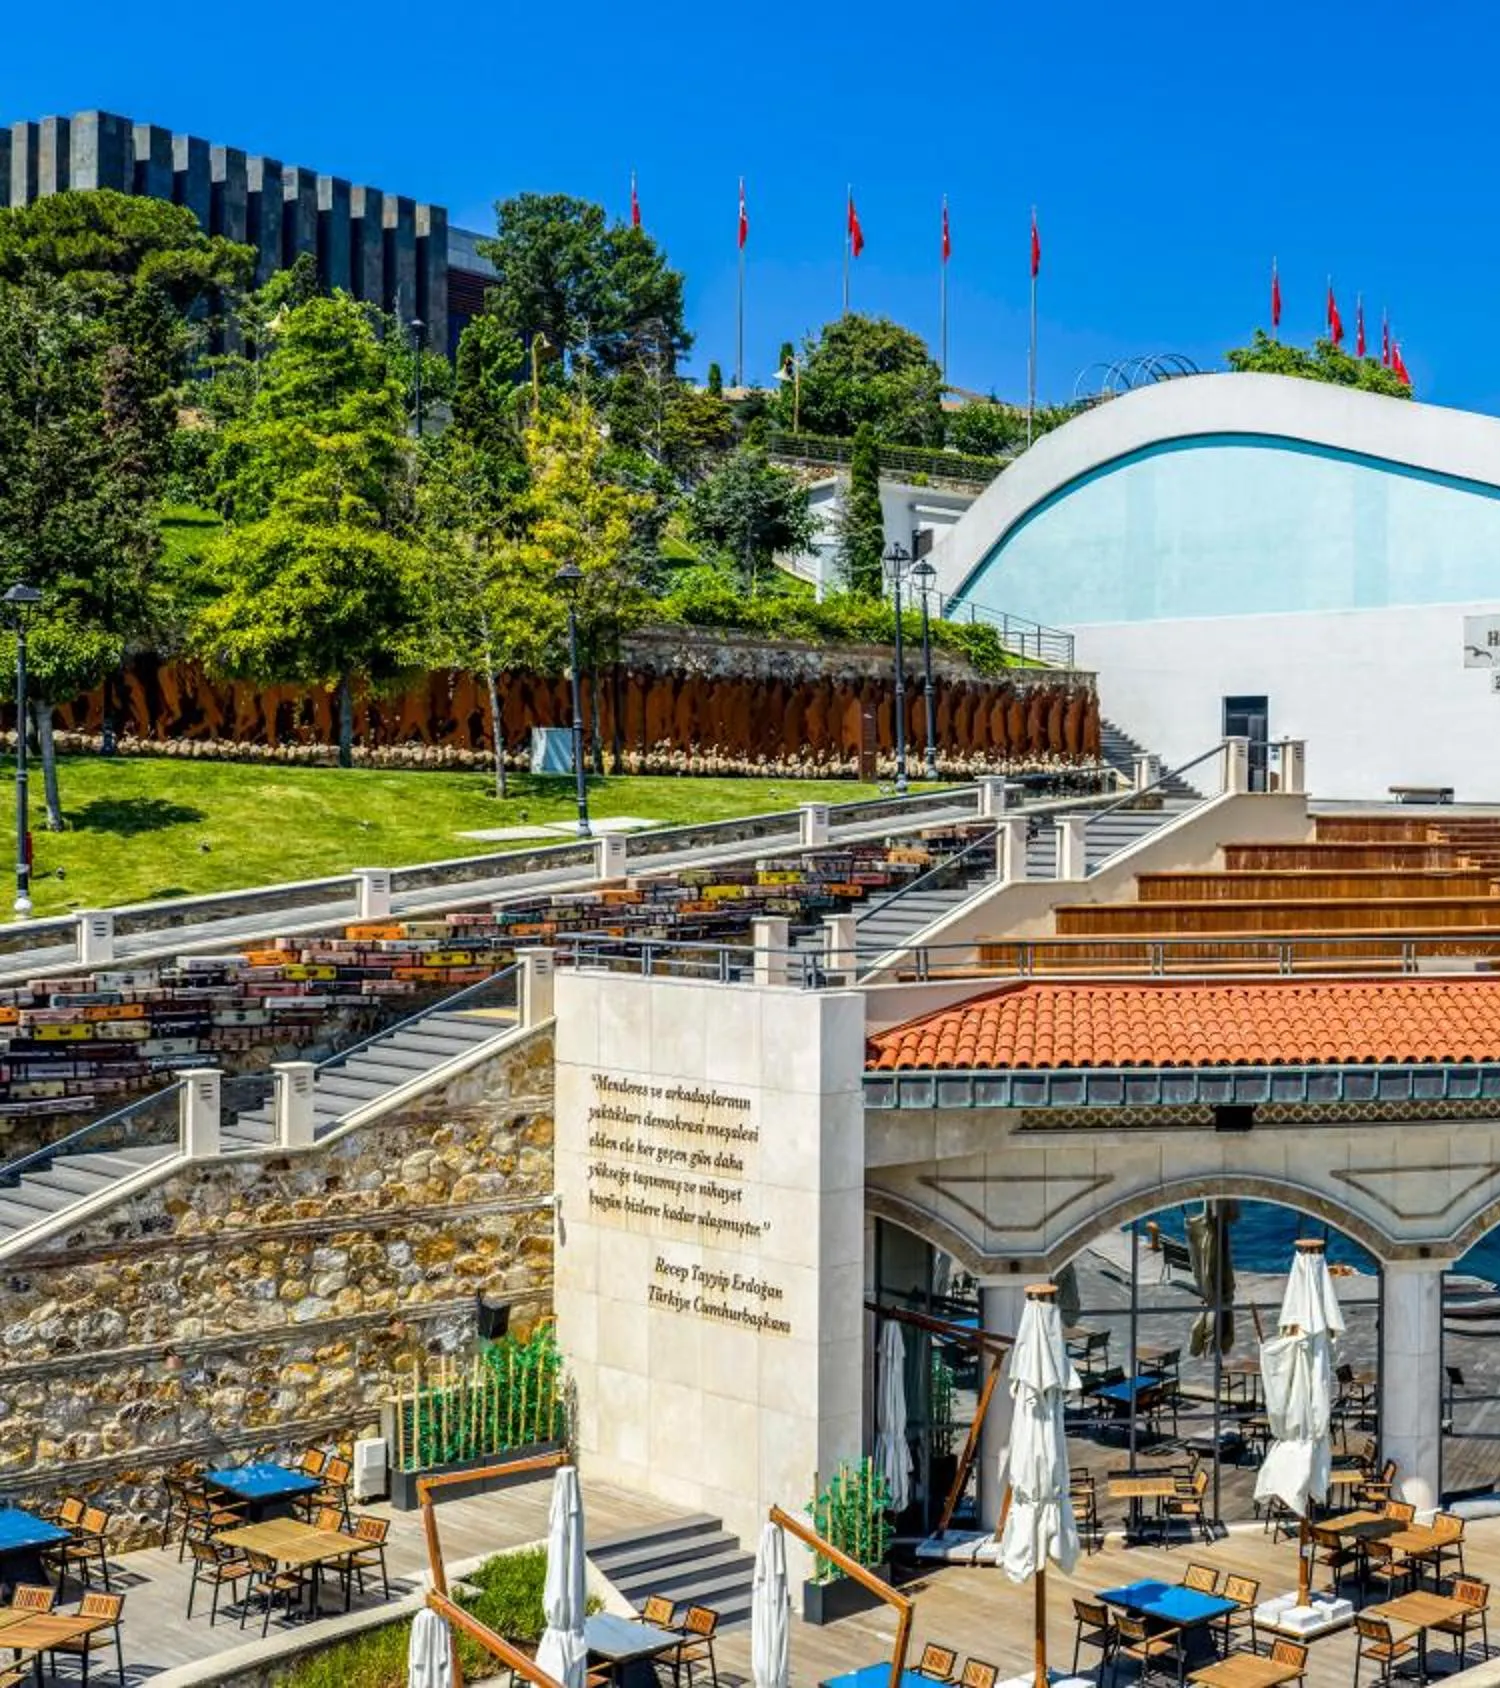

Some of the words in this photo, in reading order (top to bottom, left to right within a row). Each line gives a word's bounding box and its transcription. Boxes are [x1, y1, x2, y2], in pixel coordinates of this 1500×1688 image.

[651, 1087, 662, 1098] ve
[643, 1110, 705, 1135] demokrasi
[706, 1123, 759, 1143] meşalesi
[589, 1132, 617, 1150] elden
[620, 1136, 635, 1152] ele
[637, 1138, 655, 1156] her
[656, 1148, 687, 1164] geçen
[689, 1150, 712, 1168] gün
[714, 1151, 744, 1171] daha
[587, 1161, 631, 1187] yükseğe
[683, 1181, 697, 1193] ve
[699, 1180, 743, 1205] nihayet
[589, 1189, 622, 1212] bugün
[624, 1196, 660, 1216] bizlere
[662, 1203, 696, 1223] kadar
[655, 1256, 689, 1282] Recep
[691, 1264, 730, 1292] Tayyip
[731, 1273, 783, 1300] Erdoğan
[648, 1283, 691, 1312] Türkiye
[693, 1296, 791, 1333] Cumhurbaşkanı
